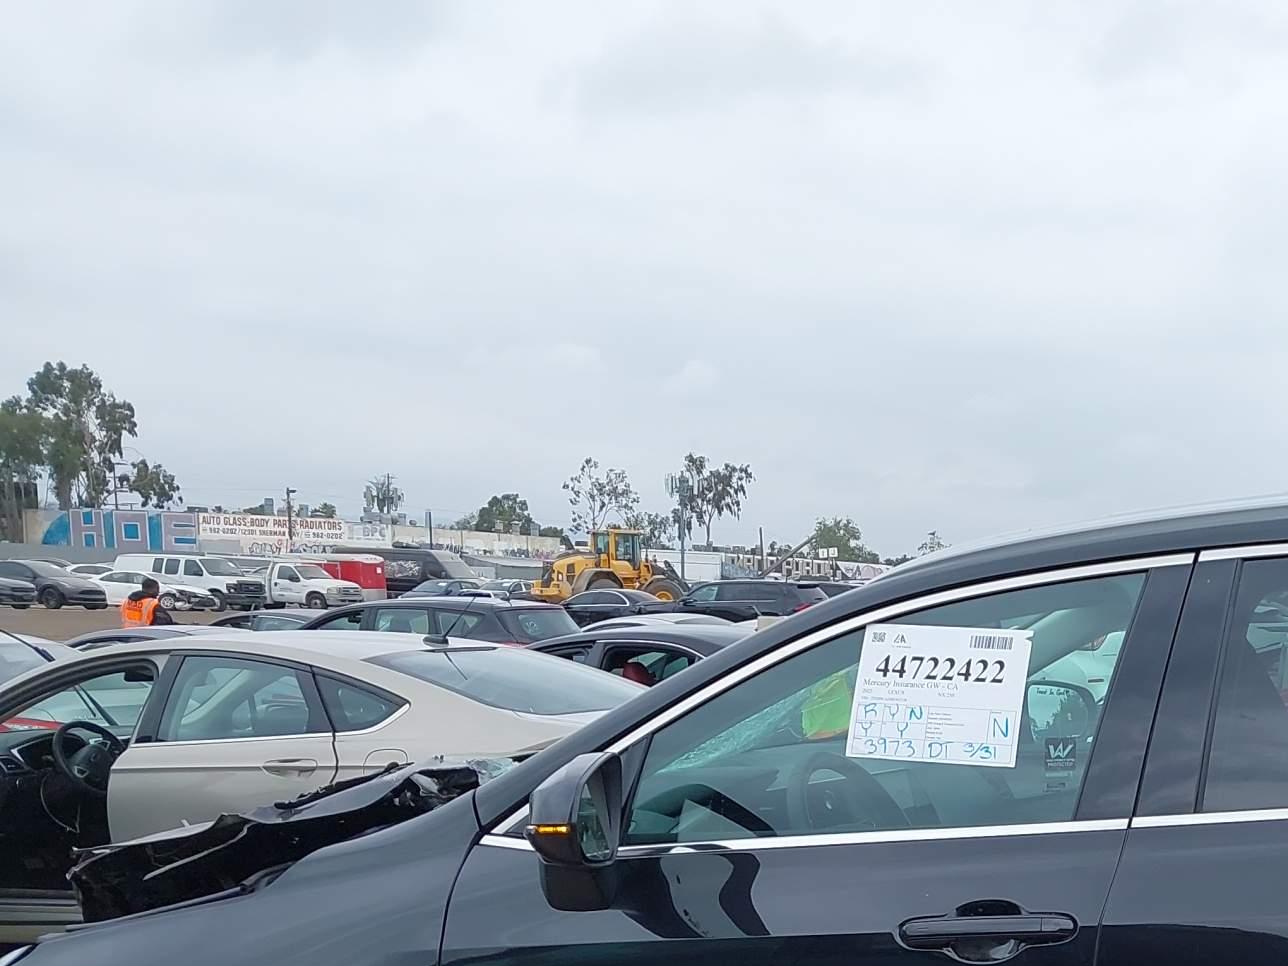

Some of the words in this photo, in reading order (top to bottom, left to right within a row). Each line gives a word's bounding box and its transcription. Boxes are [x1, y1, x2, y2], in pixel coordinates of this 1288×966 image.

[201, 515, 221, 526] AUTO
[875, 654, 1006, 684] 44722422
[863, 678, 891, 688] Mercury
[892, 679, 926, 689] Insurance
[926, 681, 939, 689] GW
[946, 682, 959, 691] CA
[909, 705, 923, 720] N
[861, 721, 873, 737] Y
[896, 721, 909, 738] Y
[992, 716, 1009, 738] N
[864, 737, 916, 758] 3973
[963, 742, 997, 760] 3/31
